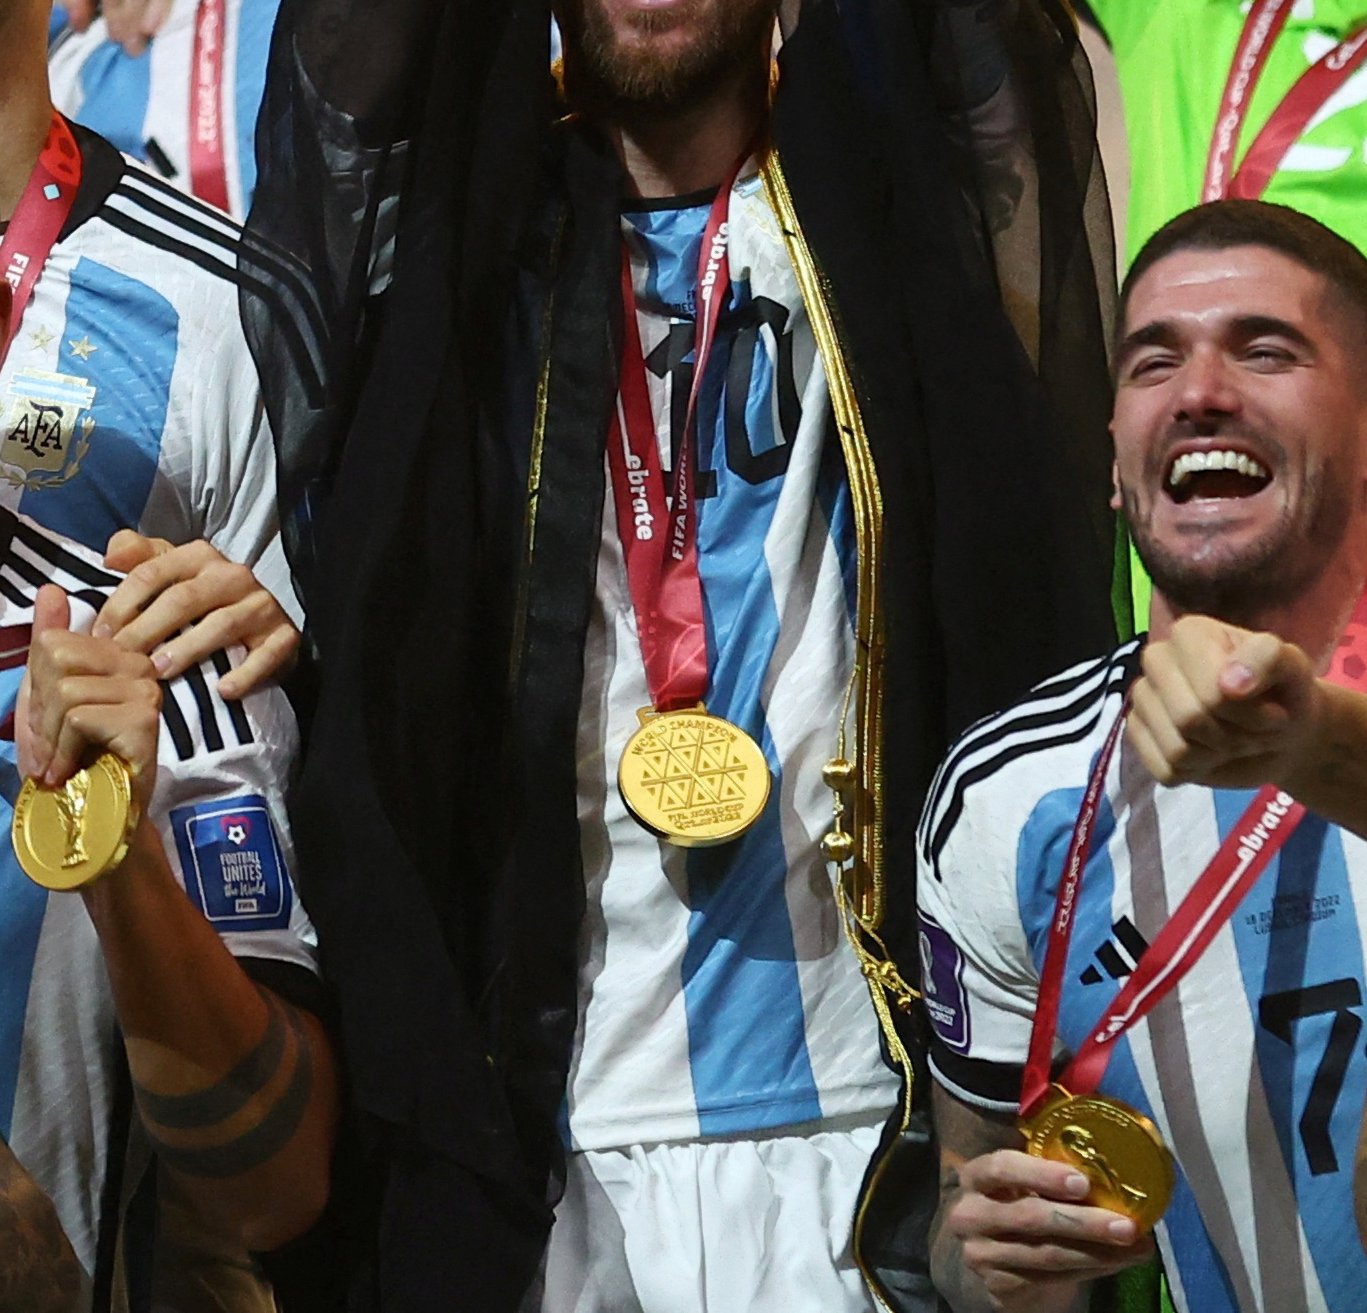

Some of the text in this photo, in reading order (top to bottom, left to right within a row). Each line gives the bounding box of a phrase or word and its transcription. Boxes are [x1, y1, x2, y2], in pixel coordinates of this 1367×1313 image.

[642, 295, 802, 499] 10
[7, 400, 65, 458] AFA
[671, 514, 687, 561] FIFA
[222, 864, 263, 883] UNITES
[1258, 977, 1363, 1177] 7
